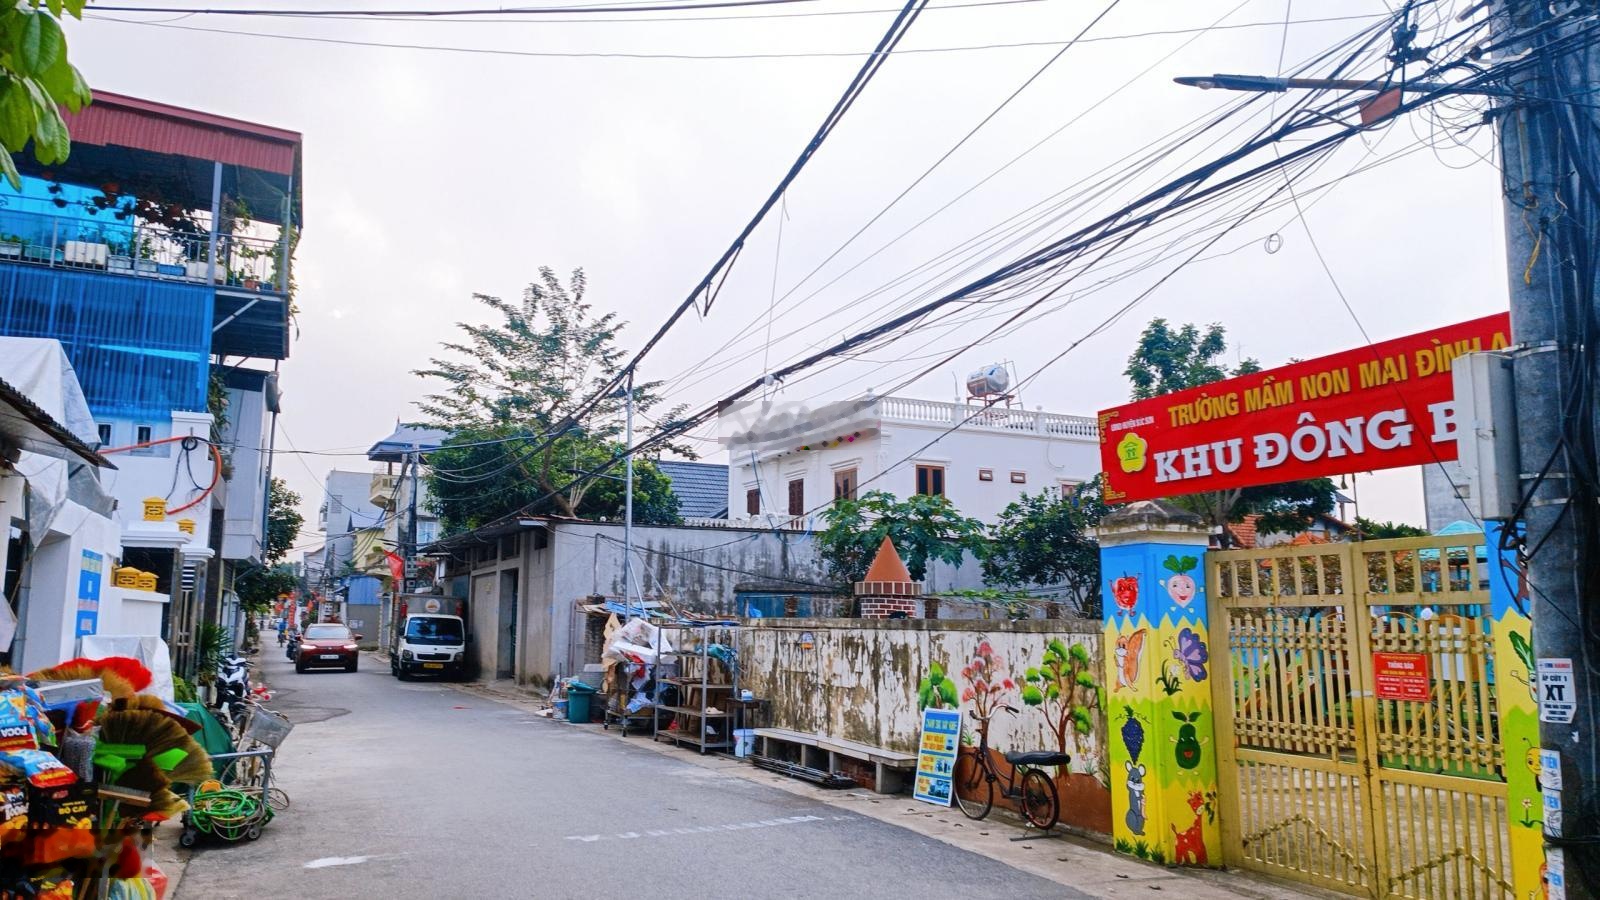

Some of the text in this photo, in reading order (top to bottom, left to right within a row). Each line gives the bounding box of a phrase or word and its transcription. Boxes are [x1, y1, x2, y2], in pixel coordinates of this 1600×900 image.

[1168, 392, 1240, 428] TRƯỜNG
[1244, 375, 1295, 412] MẦM
[1300, 367, 1351, 401] NON
[1359, 353, 1409, 389] MAI
[1153, 438, 1244, 484] KHU
[1253, 411, 1416, 470] ĐÔNG
[1544, 684, 1565, 702] XT
[0, 726, 27, 738] POCA
